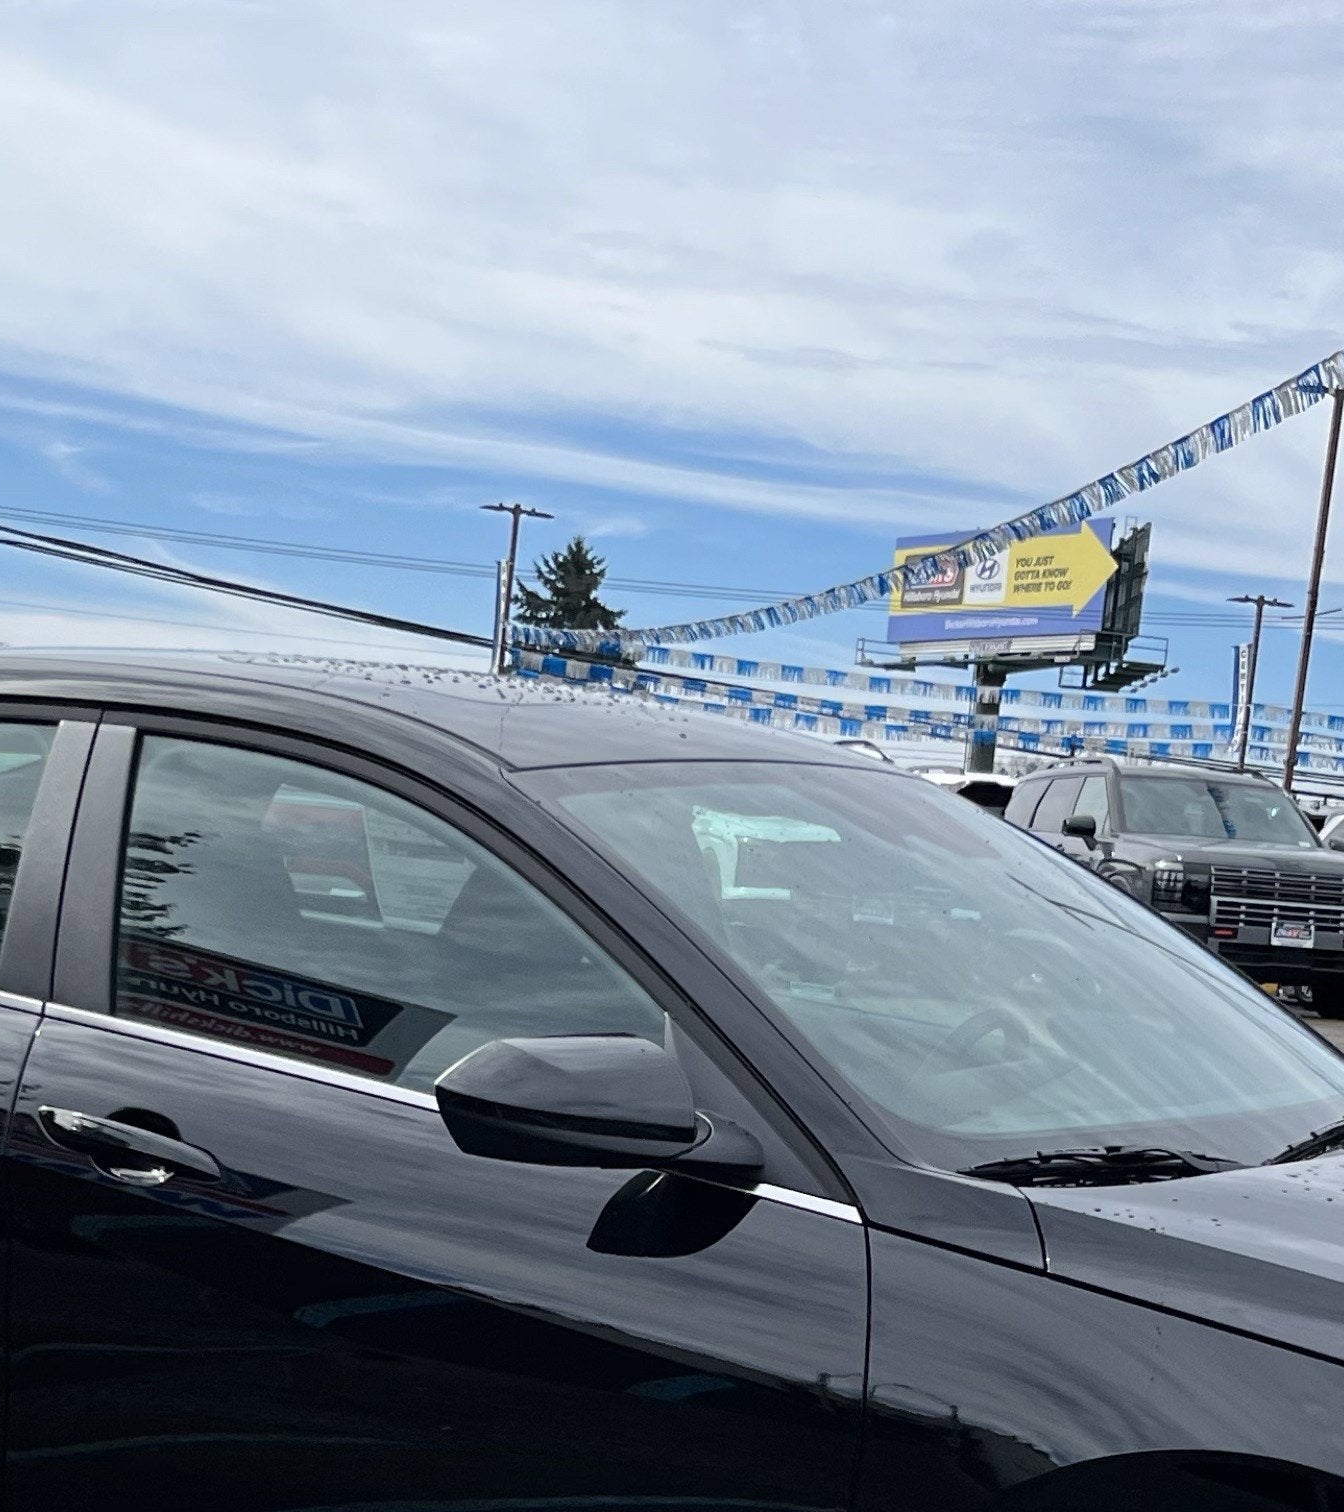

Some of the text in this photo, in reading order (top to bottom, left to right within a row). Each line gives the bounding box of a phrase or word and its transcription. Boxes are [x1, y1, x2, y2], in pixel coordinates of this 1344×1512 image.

[1016, 555, 1054, 568] YOU JUST
[1014, 567, 1069, 581] GOTTA KNOW
[1013, 582, 1043, 594] WHERE
[1044, 581, 1056, 592] TO
